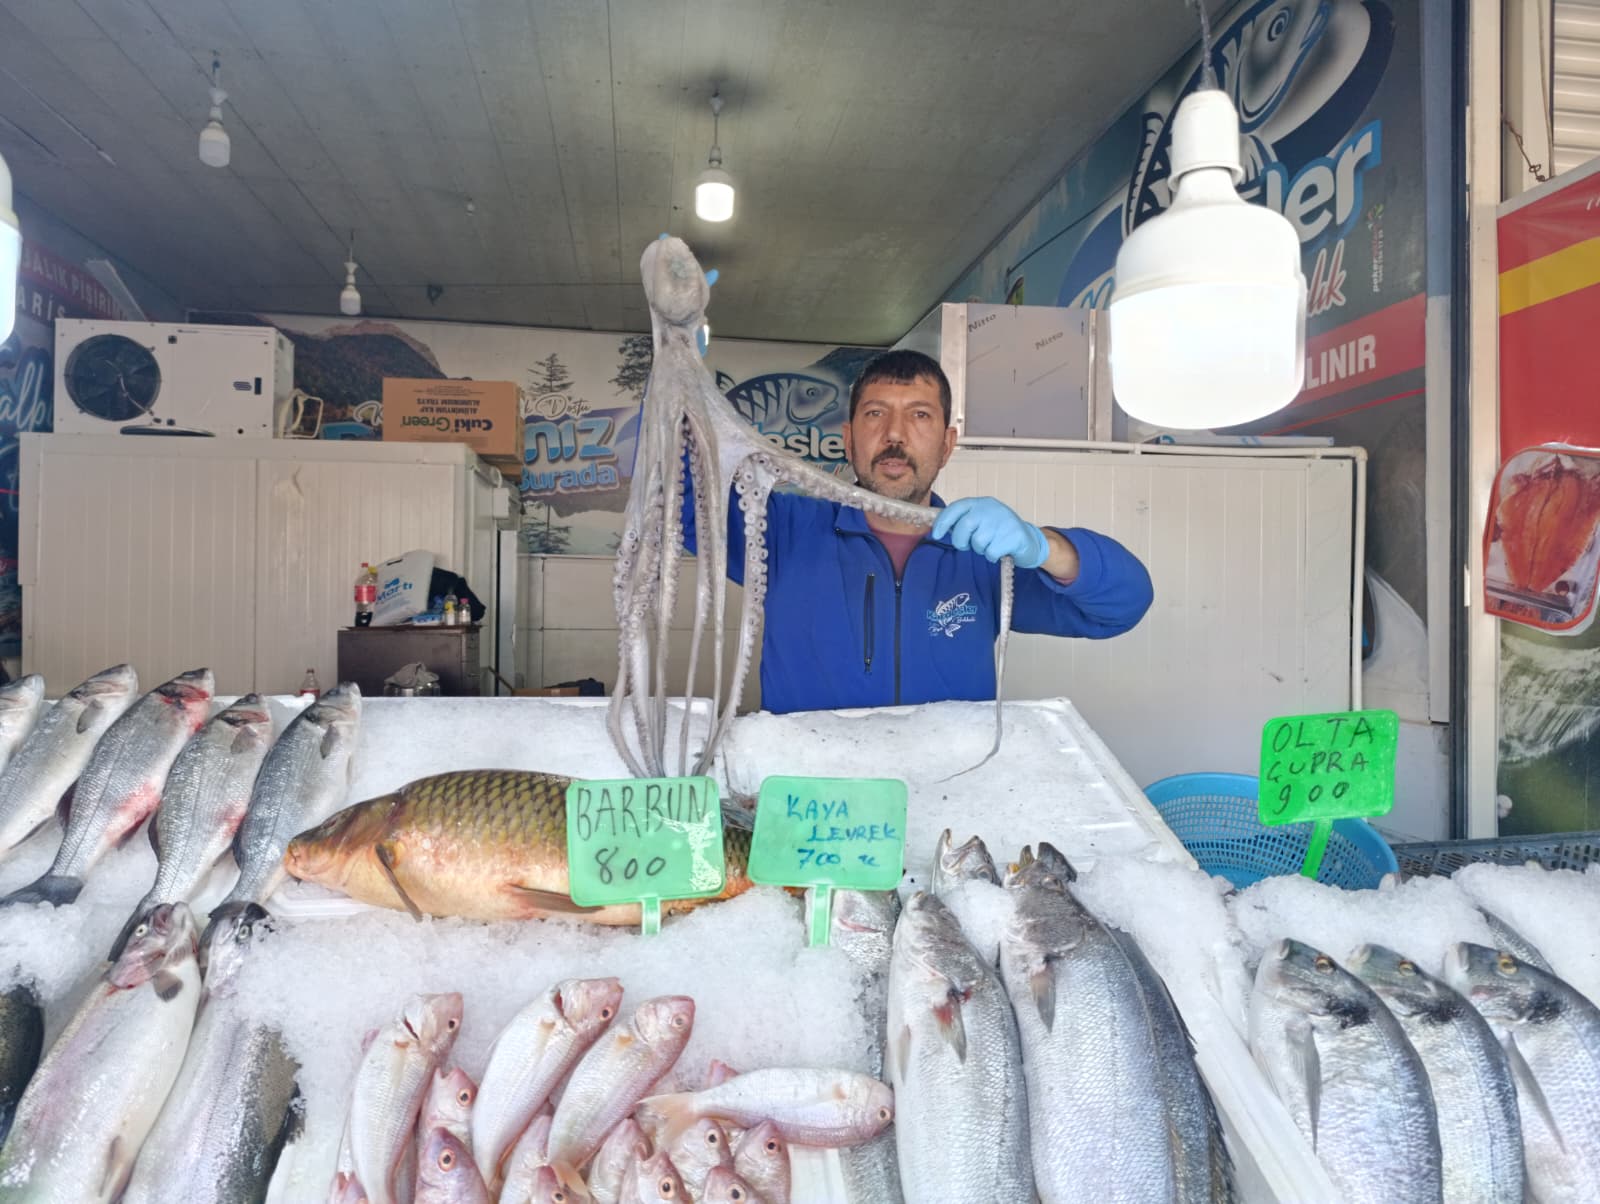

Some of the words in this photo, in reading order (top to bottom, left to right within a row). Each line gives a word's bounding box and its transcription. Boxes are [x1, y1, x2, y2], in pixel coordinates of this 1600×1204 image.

[1256, 129, 1374, 244] ler
[967, 313, 997, 333] Nitto
[1034, 331, 1064, 350] Nitto
[1302, 334, 1377, 393] LINIR
[402, 415, 451, 432] Green
[454, 418, 493, 432] Cuki
[576, 780, 709, 842] BARBUN
[787, 793, 849, 821] KAYA
[594, 846, 667, 885] 800
[797, 848, 841, 869] 700
